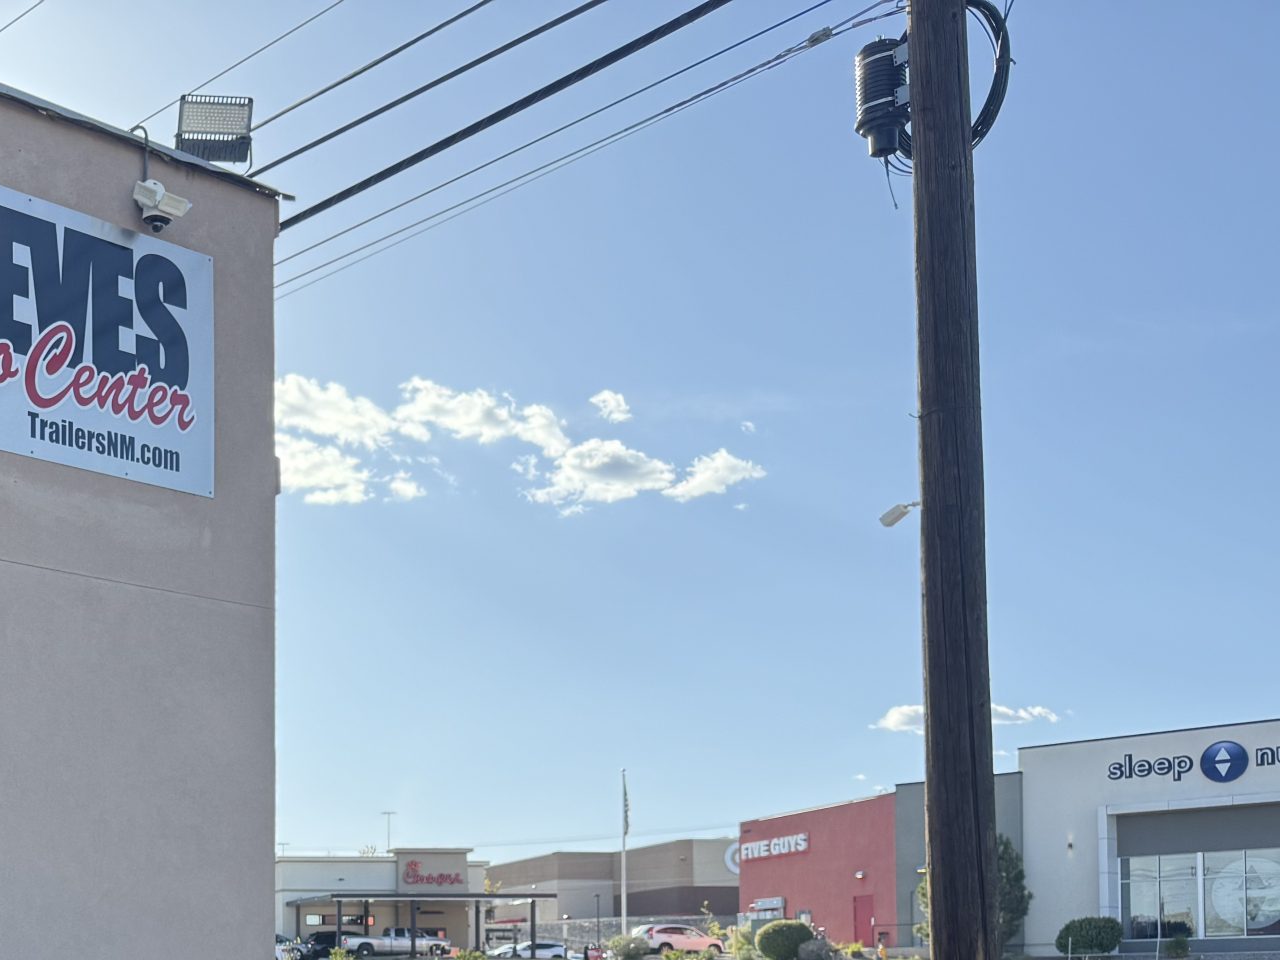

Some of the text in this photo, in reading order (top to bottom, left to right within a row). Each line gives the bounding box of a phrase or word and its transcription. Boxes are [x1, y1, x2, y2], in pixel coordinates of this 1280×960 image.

[23, 323, 196, 433] Center
[27, 410, 181, 474] TrailersNM.com
[1107, 753, 1194, 782] sleep
[741, 832, 809, 861] FIVE GUYS
